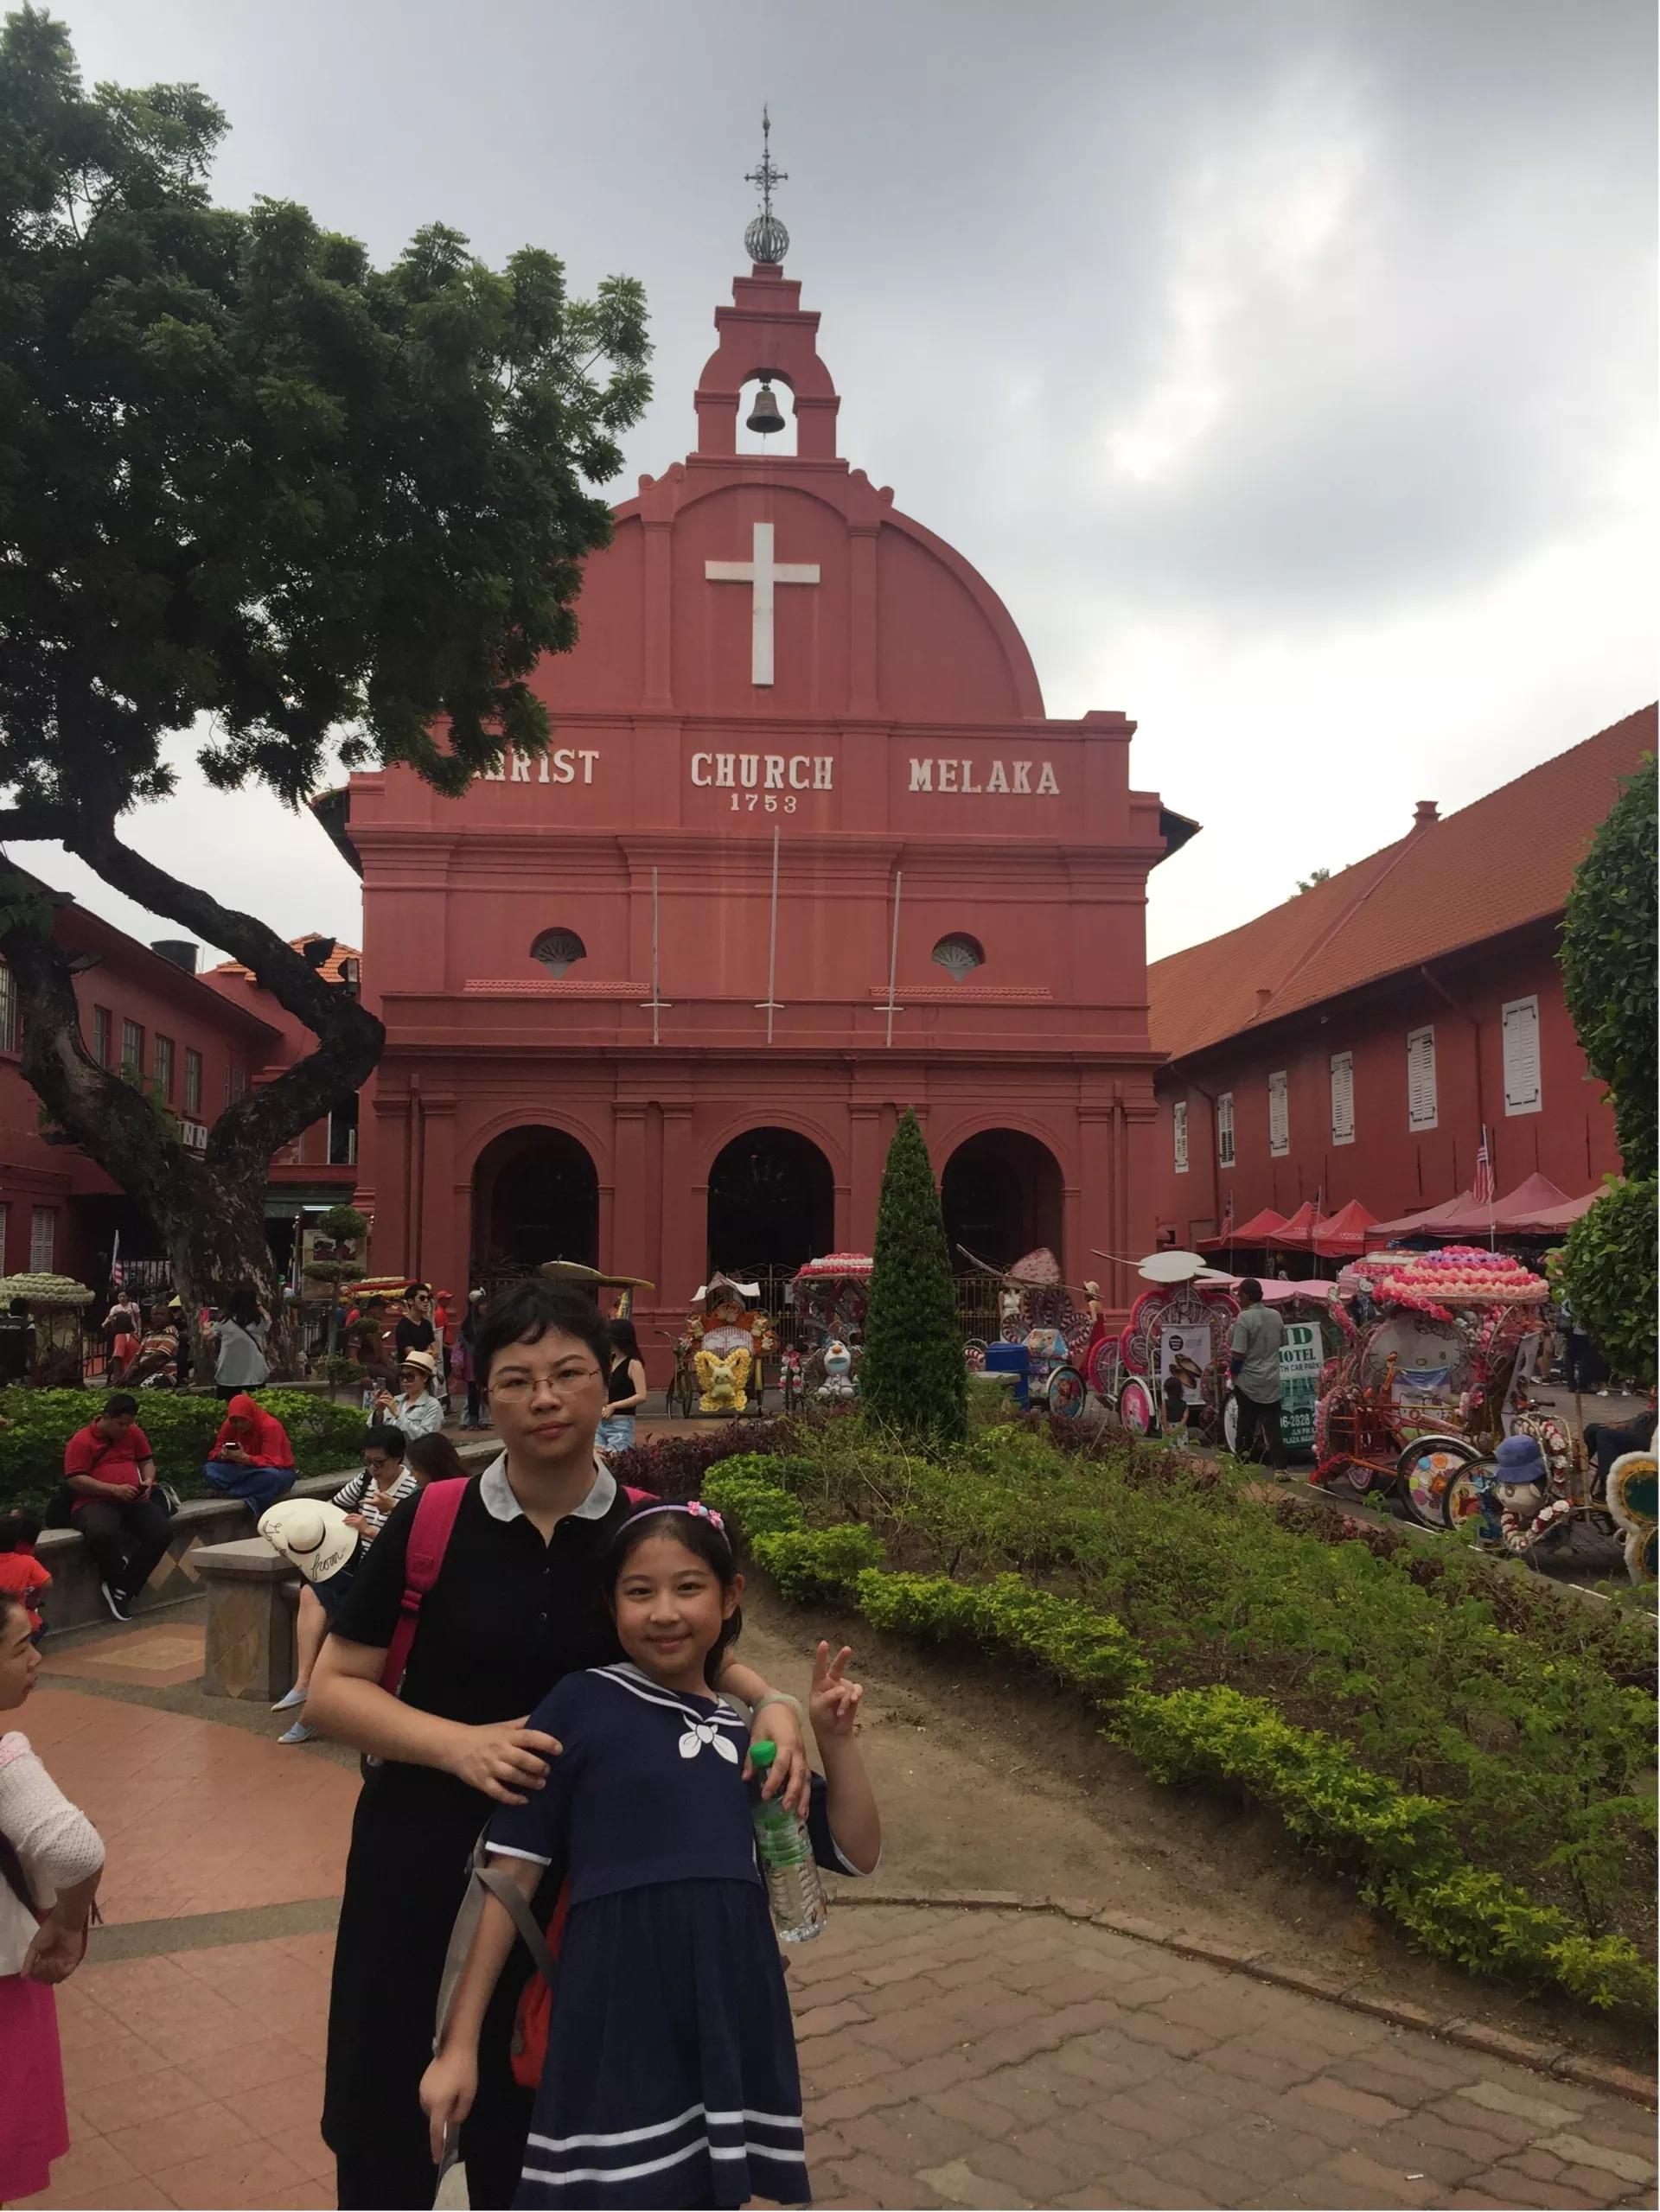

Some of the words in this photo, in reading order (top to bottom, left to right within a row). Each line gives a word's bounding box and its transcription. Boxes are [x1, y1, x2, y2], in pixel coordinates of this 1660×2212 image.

[692, 753, 833, 790] CHURCH
[909, 758, 1060, 794] MELAKA
[731, 794, 797, 813] 1753
